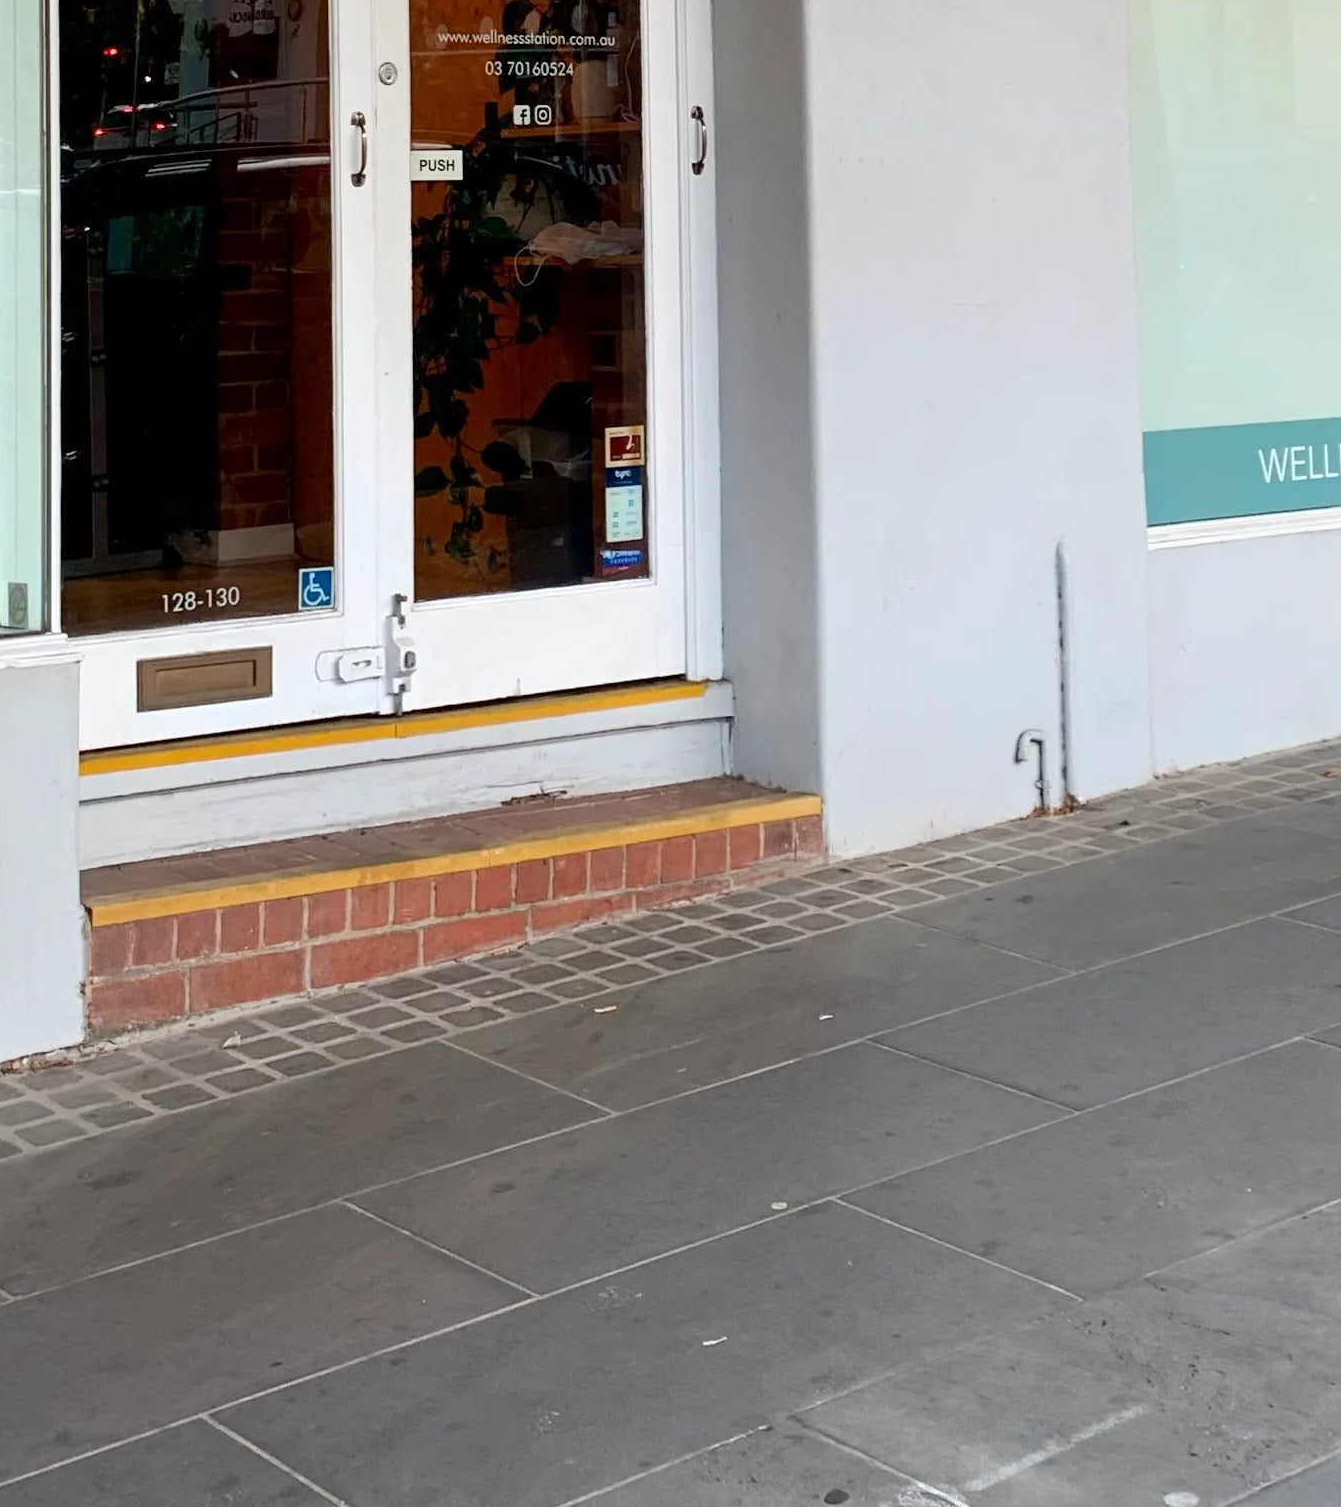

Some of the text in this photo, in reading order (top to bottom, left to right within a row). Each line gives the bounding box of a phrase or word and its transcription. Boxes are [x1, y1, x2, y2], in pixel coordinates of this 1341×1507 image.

[437, 29, 616, 47] www.wellnessstation.com.au
[484, 61, 575, 77] 03 70160524
[418, 158, 456, 173] PUSH
[161, 586, 241, 614] 128-130
